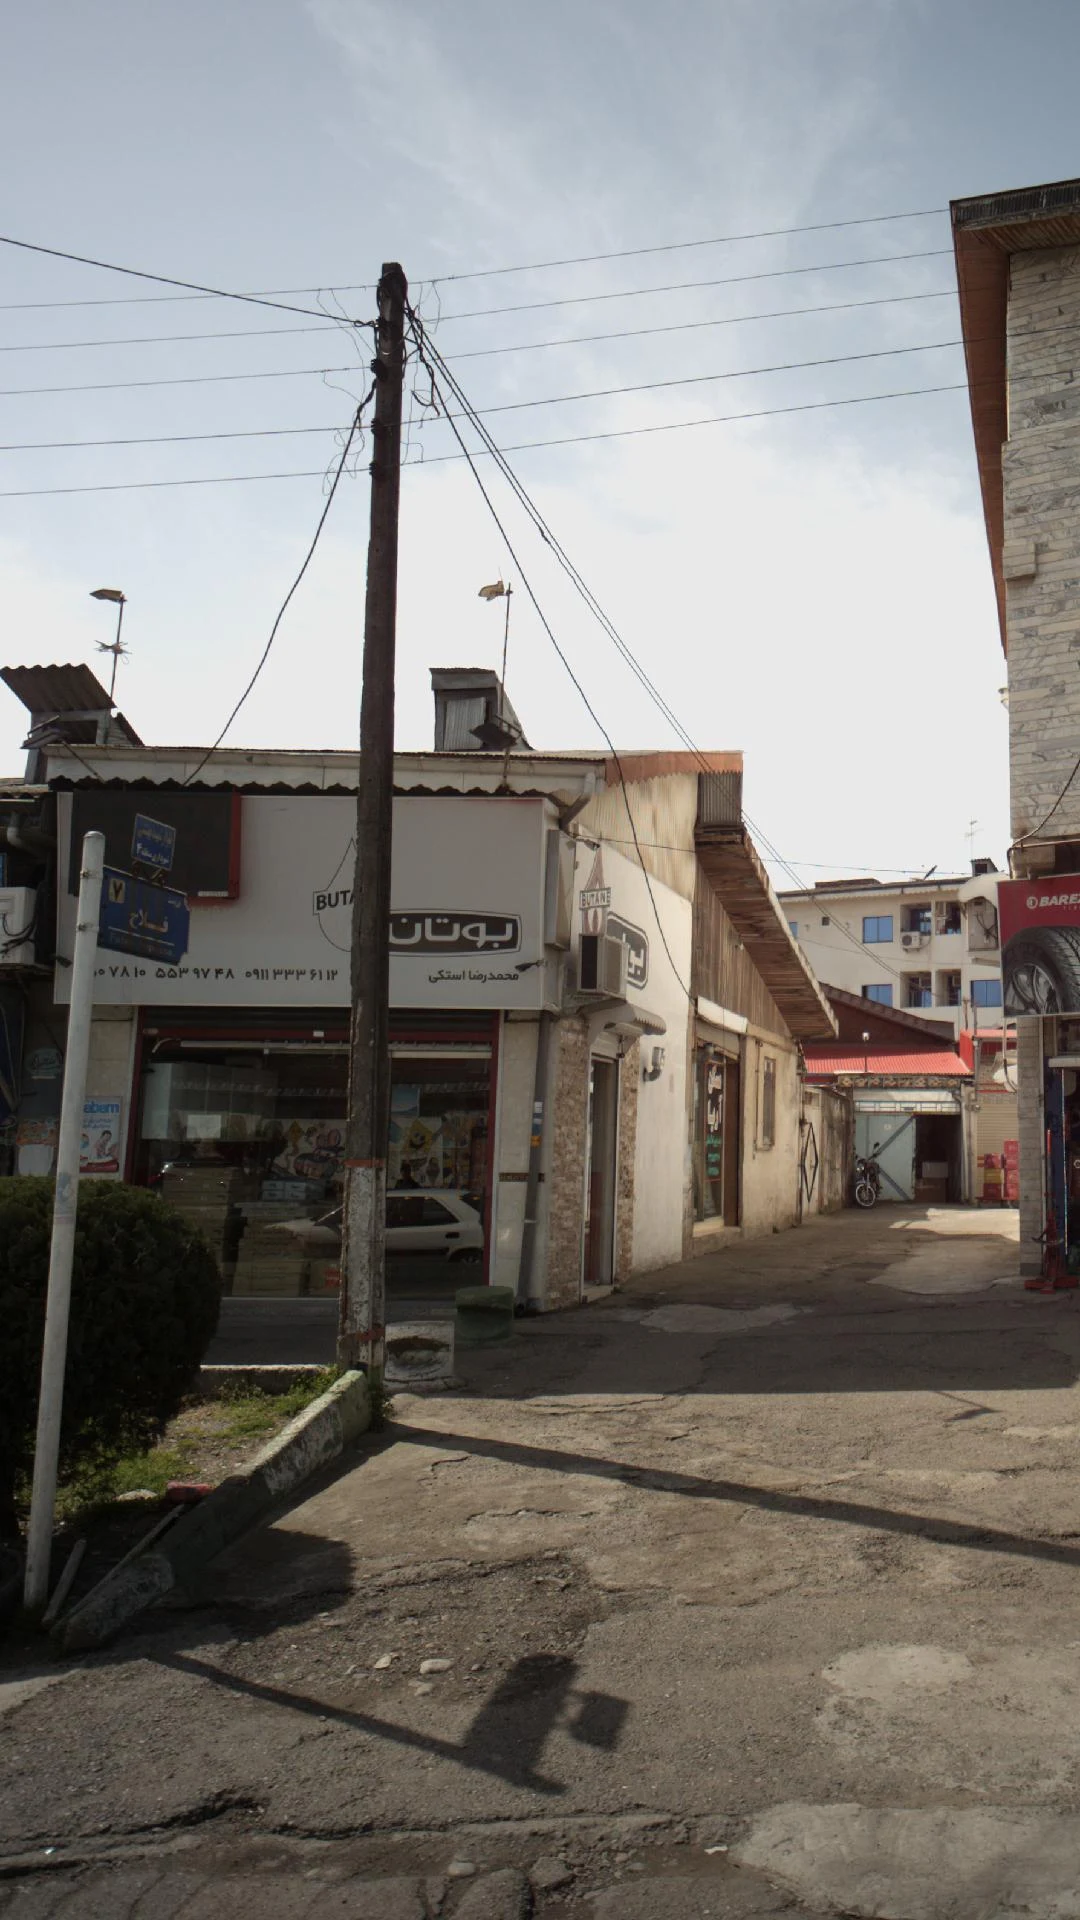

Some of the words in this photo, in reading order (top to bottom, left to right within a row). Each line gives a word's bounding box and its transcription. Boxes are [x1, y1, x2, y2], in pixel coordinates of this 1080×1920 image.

[113, 881, 123, 901] ۷
[581, 889, 612, 907] BUTANE
[1039, 894, 1080, 907] BARE
[129, 909, 169, 933] فلاح
[388, 917, 513, 949] بوتان
[428, 968, 465, 984] استکی
[467, 969, 519, 983] محمدرضا
